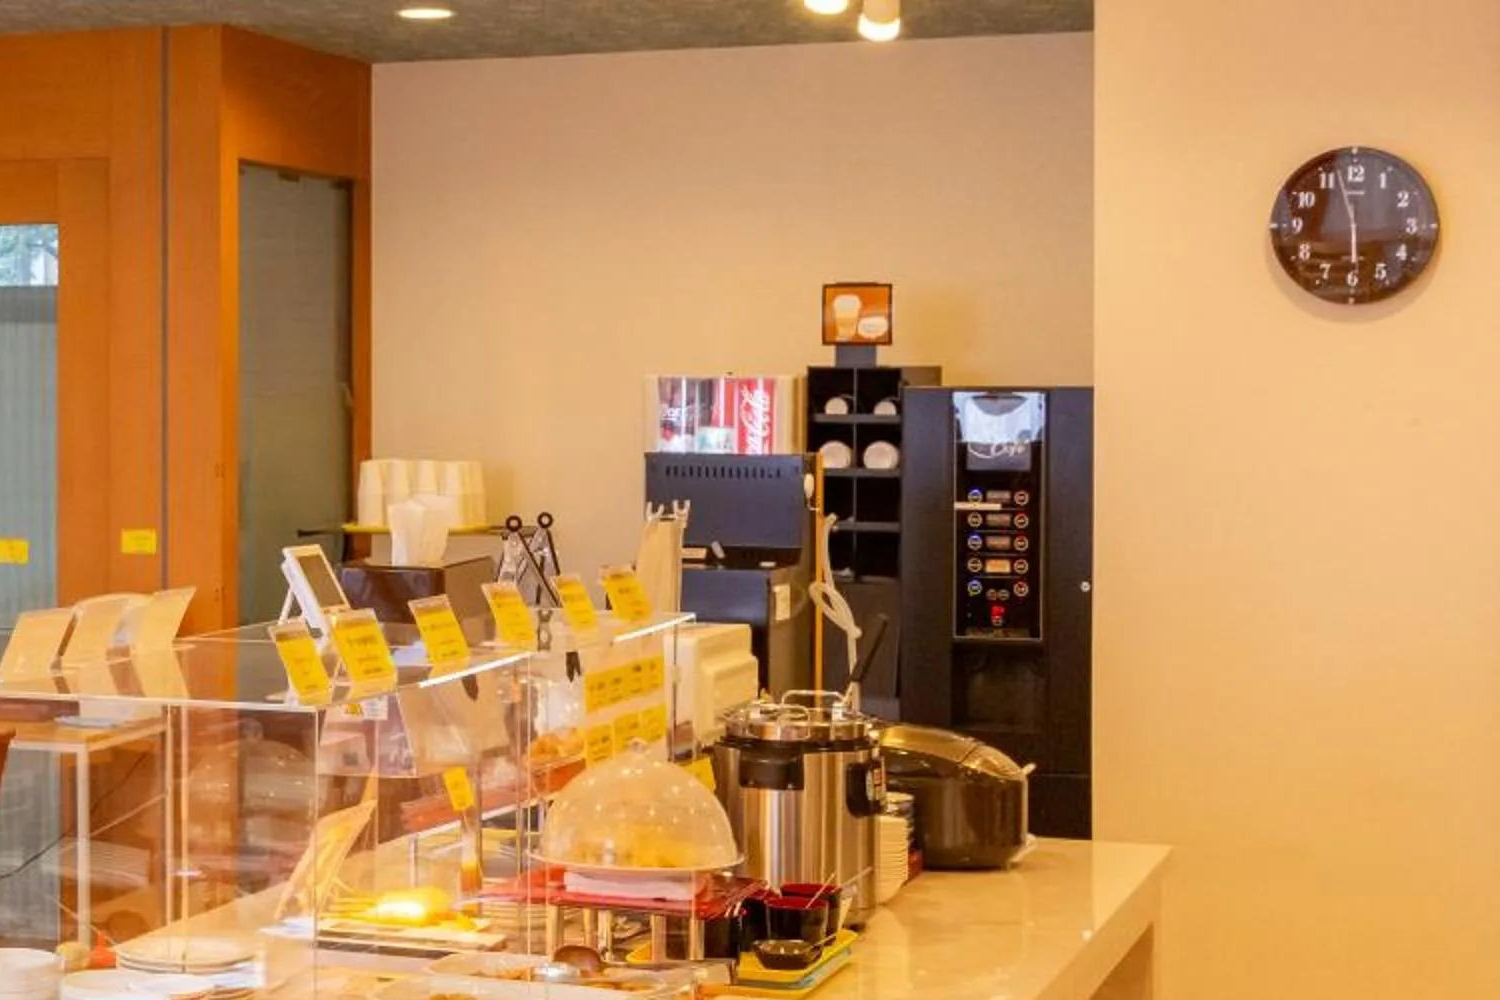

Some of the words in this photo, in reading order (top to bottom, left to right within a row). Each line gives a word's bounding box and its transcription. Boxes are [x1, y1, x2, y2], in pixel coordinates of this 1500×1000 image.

[1320, 172, 1335, 189] 11
[1347, 165, 1365, 182] 12
[1379, 172, 1387, 189] 1
[1297, 191, 1316, 209] 10
[1396, 190, 1410, 208] 2
[1292, 218, 1303, 234] 9
[1405, 218, 1417, 235] 3
[1299, 242, 1311, 261] 8
[1396, 244, 1407, 260] 4
[1320, 263, 1331, 279] 7
[1347, 269, 1358, 286] 6
[1373, 263, 1387, 279] 5
